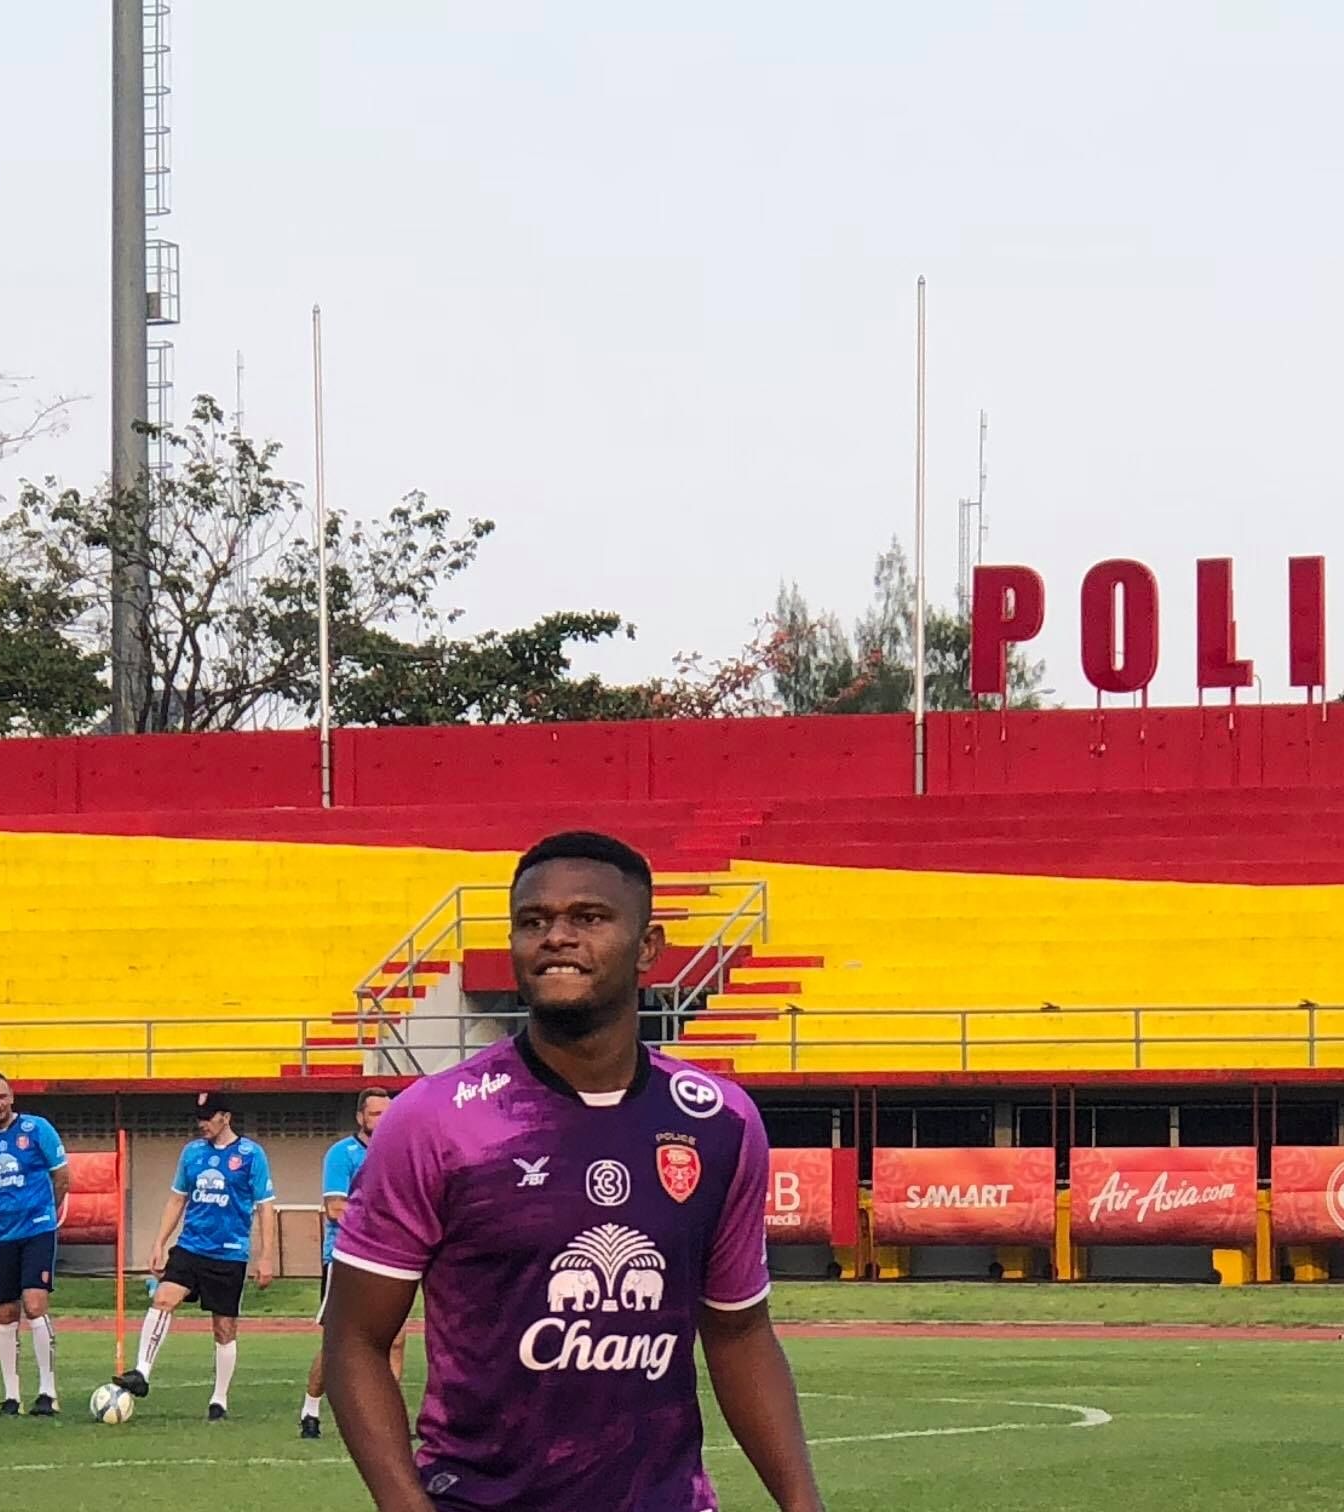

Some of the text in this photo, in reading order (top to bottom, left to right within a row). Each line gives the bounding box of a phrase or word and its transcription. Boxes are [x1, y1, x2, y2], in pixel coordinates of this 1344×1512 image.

[677, 1081, 716, 1104] CP
[655, 1132, 696, 1145] POLICE
[192, 1189, 230, 1207] Chang
[906, 1184, 1014, 1209] SAMART
[519, 1317, 678, 1381] Chang
